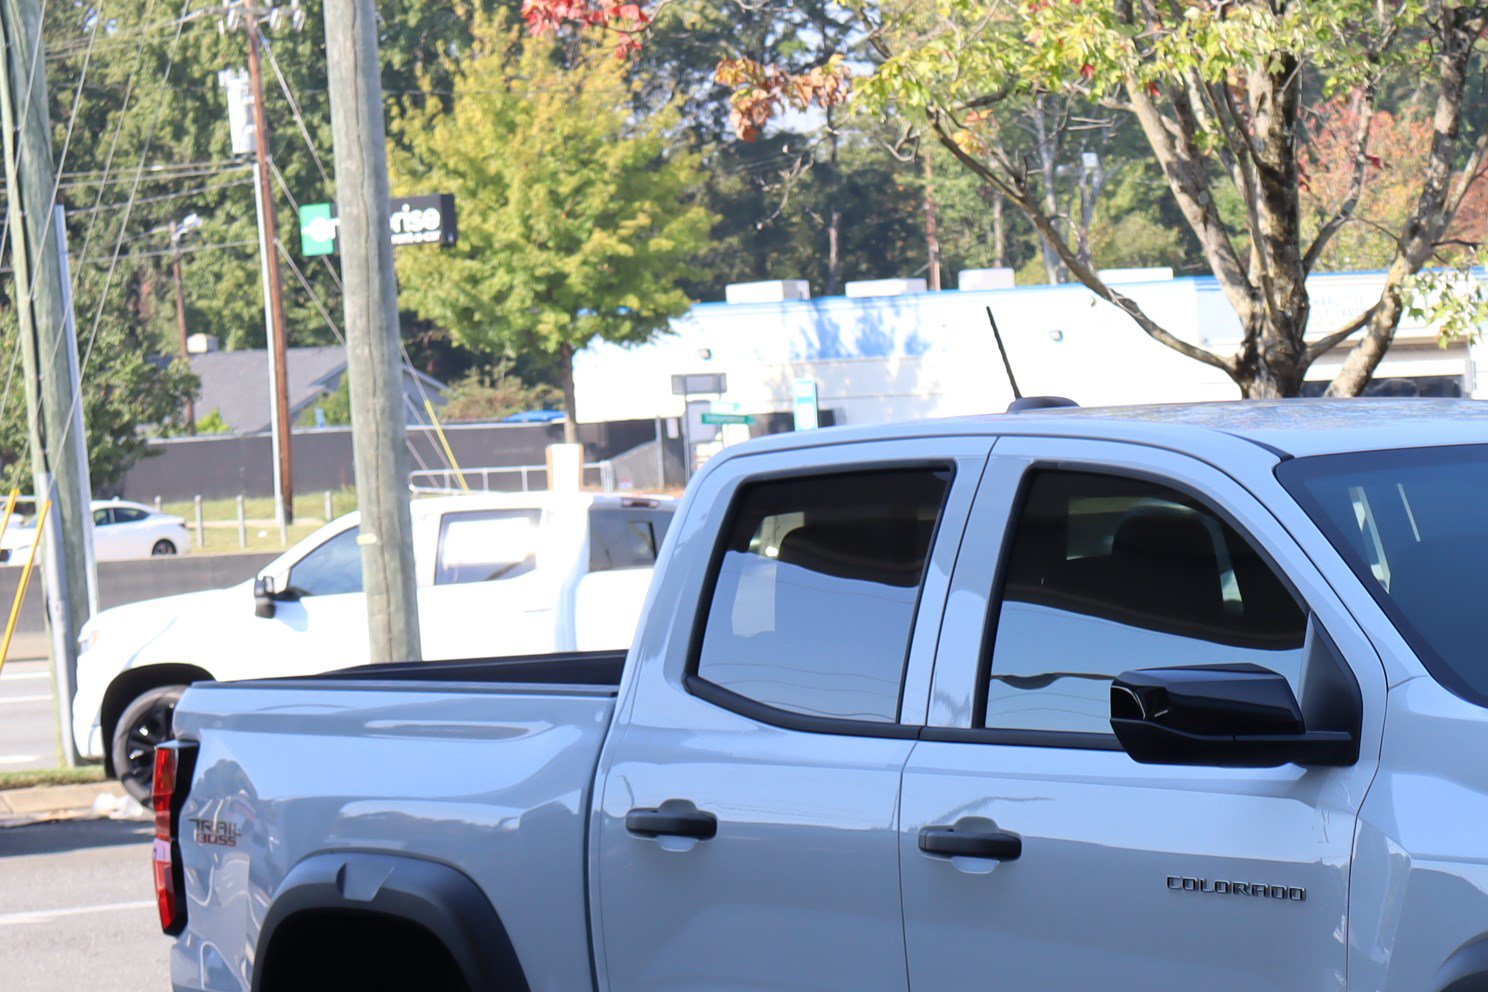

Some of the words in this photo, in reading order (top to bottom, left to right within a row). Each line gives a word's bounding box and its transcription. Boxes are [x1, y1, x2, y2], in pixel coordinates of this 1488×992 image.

[189, 818, 242, 837] TRAIL
[196, 833, 236, 847] BOSS
[1167, 875, 1307, 901] COLORADO
